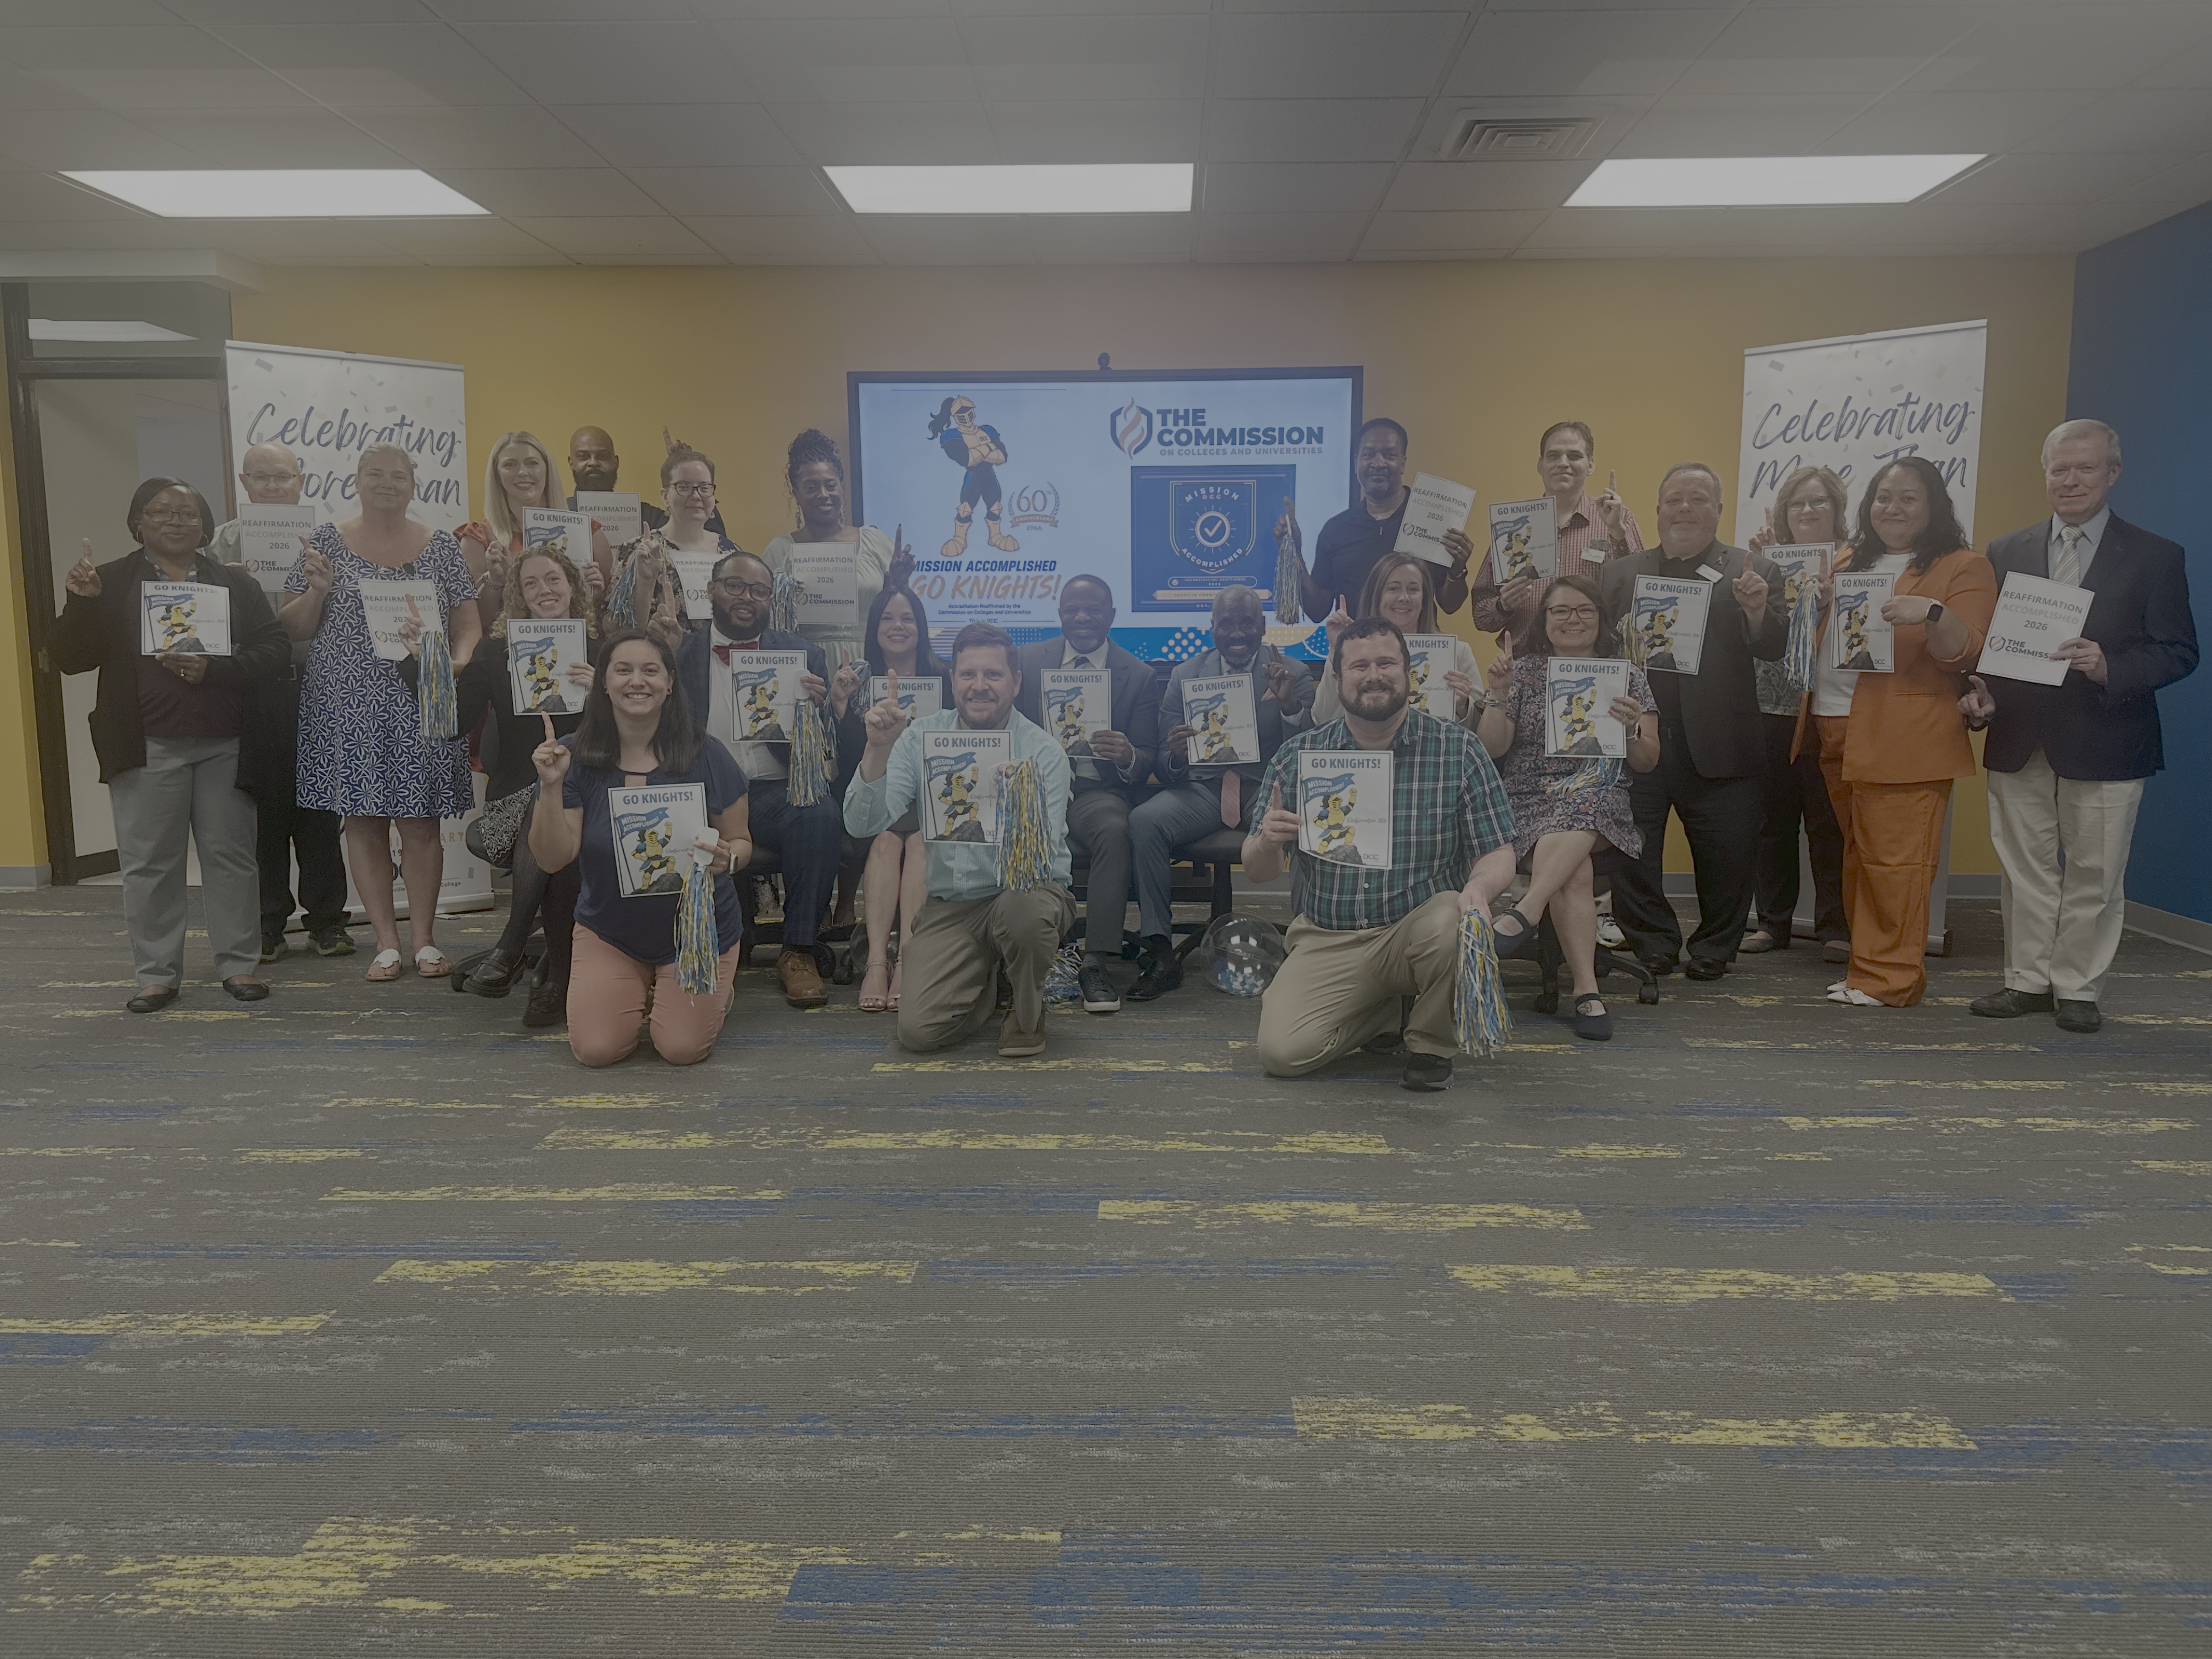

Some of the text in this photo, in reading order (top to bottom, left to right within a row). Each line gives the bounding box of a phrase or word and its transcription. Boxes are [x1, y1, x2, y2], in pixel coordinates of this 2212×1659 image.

[1156, 408, 1206, 427] THE
[1752, 391, 1975, 449] Celebrating
[247, 403, 461, 468] Celebrating
[1157, 426, 1323, 447] COMMISSION
[1255, 447, 1323, 455] UNIVERSITIES
[1185, 487, 1239, 503] MISSION
[1413, 487, 1468, 509] REAFFIRMATION
[1412, 498, 1464, 518] ACCOMPLISHED
[1511, 503, 1548, 514] KNIGHTS!
[547, 514, 583, 525] KNIGHTS!
[1427, 512, 1444, 521] 2026
[242, 520, 311, 528] REAFFIRMATION
[1414, 532, 1440, 543] COMMIS
[1181, 548, 1242, 567] ACCOMPLISHED
[1772, 549, 1821, 559] GO KNIGHTS
[966, 561, 1057, 572] ACCOMPLISHED
[911, 574, 1062, 601] GO KNIGHTS!
[1646, 583, 1702, 595] GO KNIGHTS!
[1842, 579, 1887, 588] GO KNIGHTS!
[172, 585, 218, 594] KNIGHTS!
[2003, 591, 2083, 614] REAFFIRMATION
[2001, 603, 2079, 624] ACCOMPLISHED
[518, 625, 575, 634] GO KNIGHTS!
[2024, 620, 2048, 631] 2026
[1409, 640, 1449, 648] KNIGHTS!
[2008, 639, 2026, 647] THE
[2005, 646, 2053, 659] COMMISS
[741, 656, 798, 665] GO KNIGHTS!
[1559, 664, 1619, 675] GO KNIGHTS!
[1064, 675, 1102, 683] KNIGHTS!
[898, 682, 934, 691] KNIGHTS!
[1192, 680, 1244, 692] GO KNIGHTS!
[1555, 681, 1576, 690] MISSION
[934, 737, 1001, 747] GO KNIGHTS!
[931, 758, 955, 768] MISSION
[932, 760, 967, 775] ACCOMPLISHED!
[1311, 758, 1381, 769] GO KNIGHTS!
[1307, 780, 1332, 790] MISSION
[1308, 783, 1345, 797] ACCOMPLISHED!
[623, 791, 693, 805] GO KNIGHTS!
[621, 815, 646, 826] MISSION
